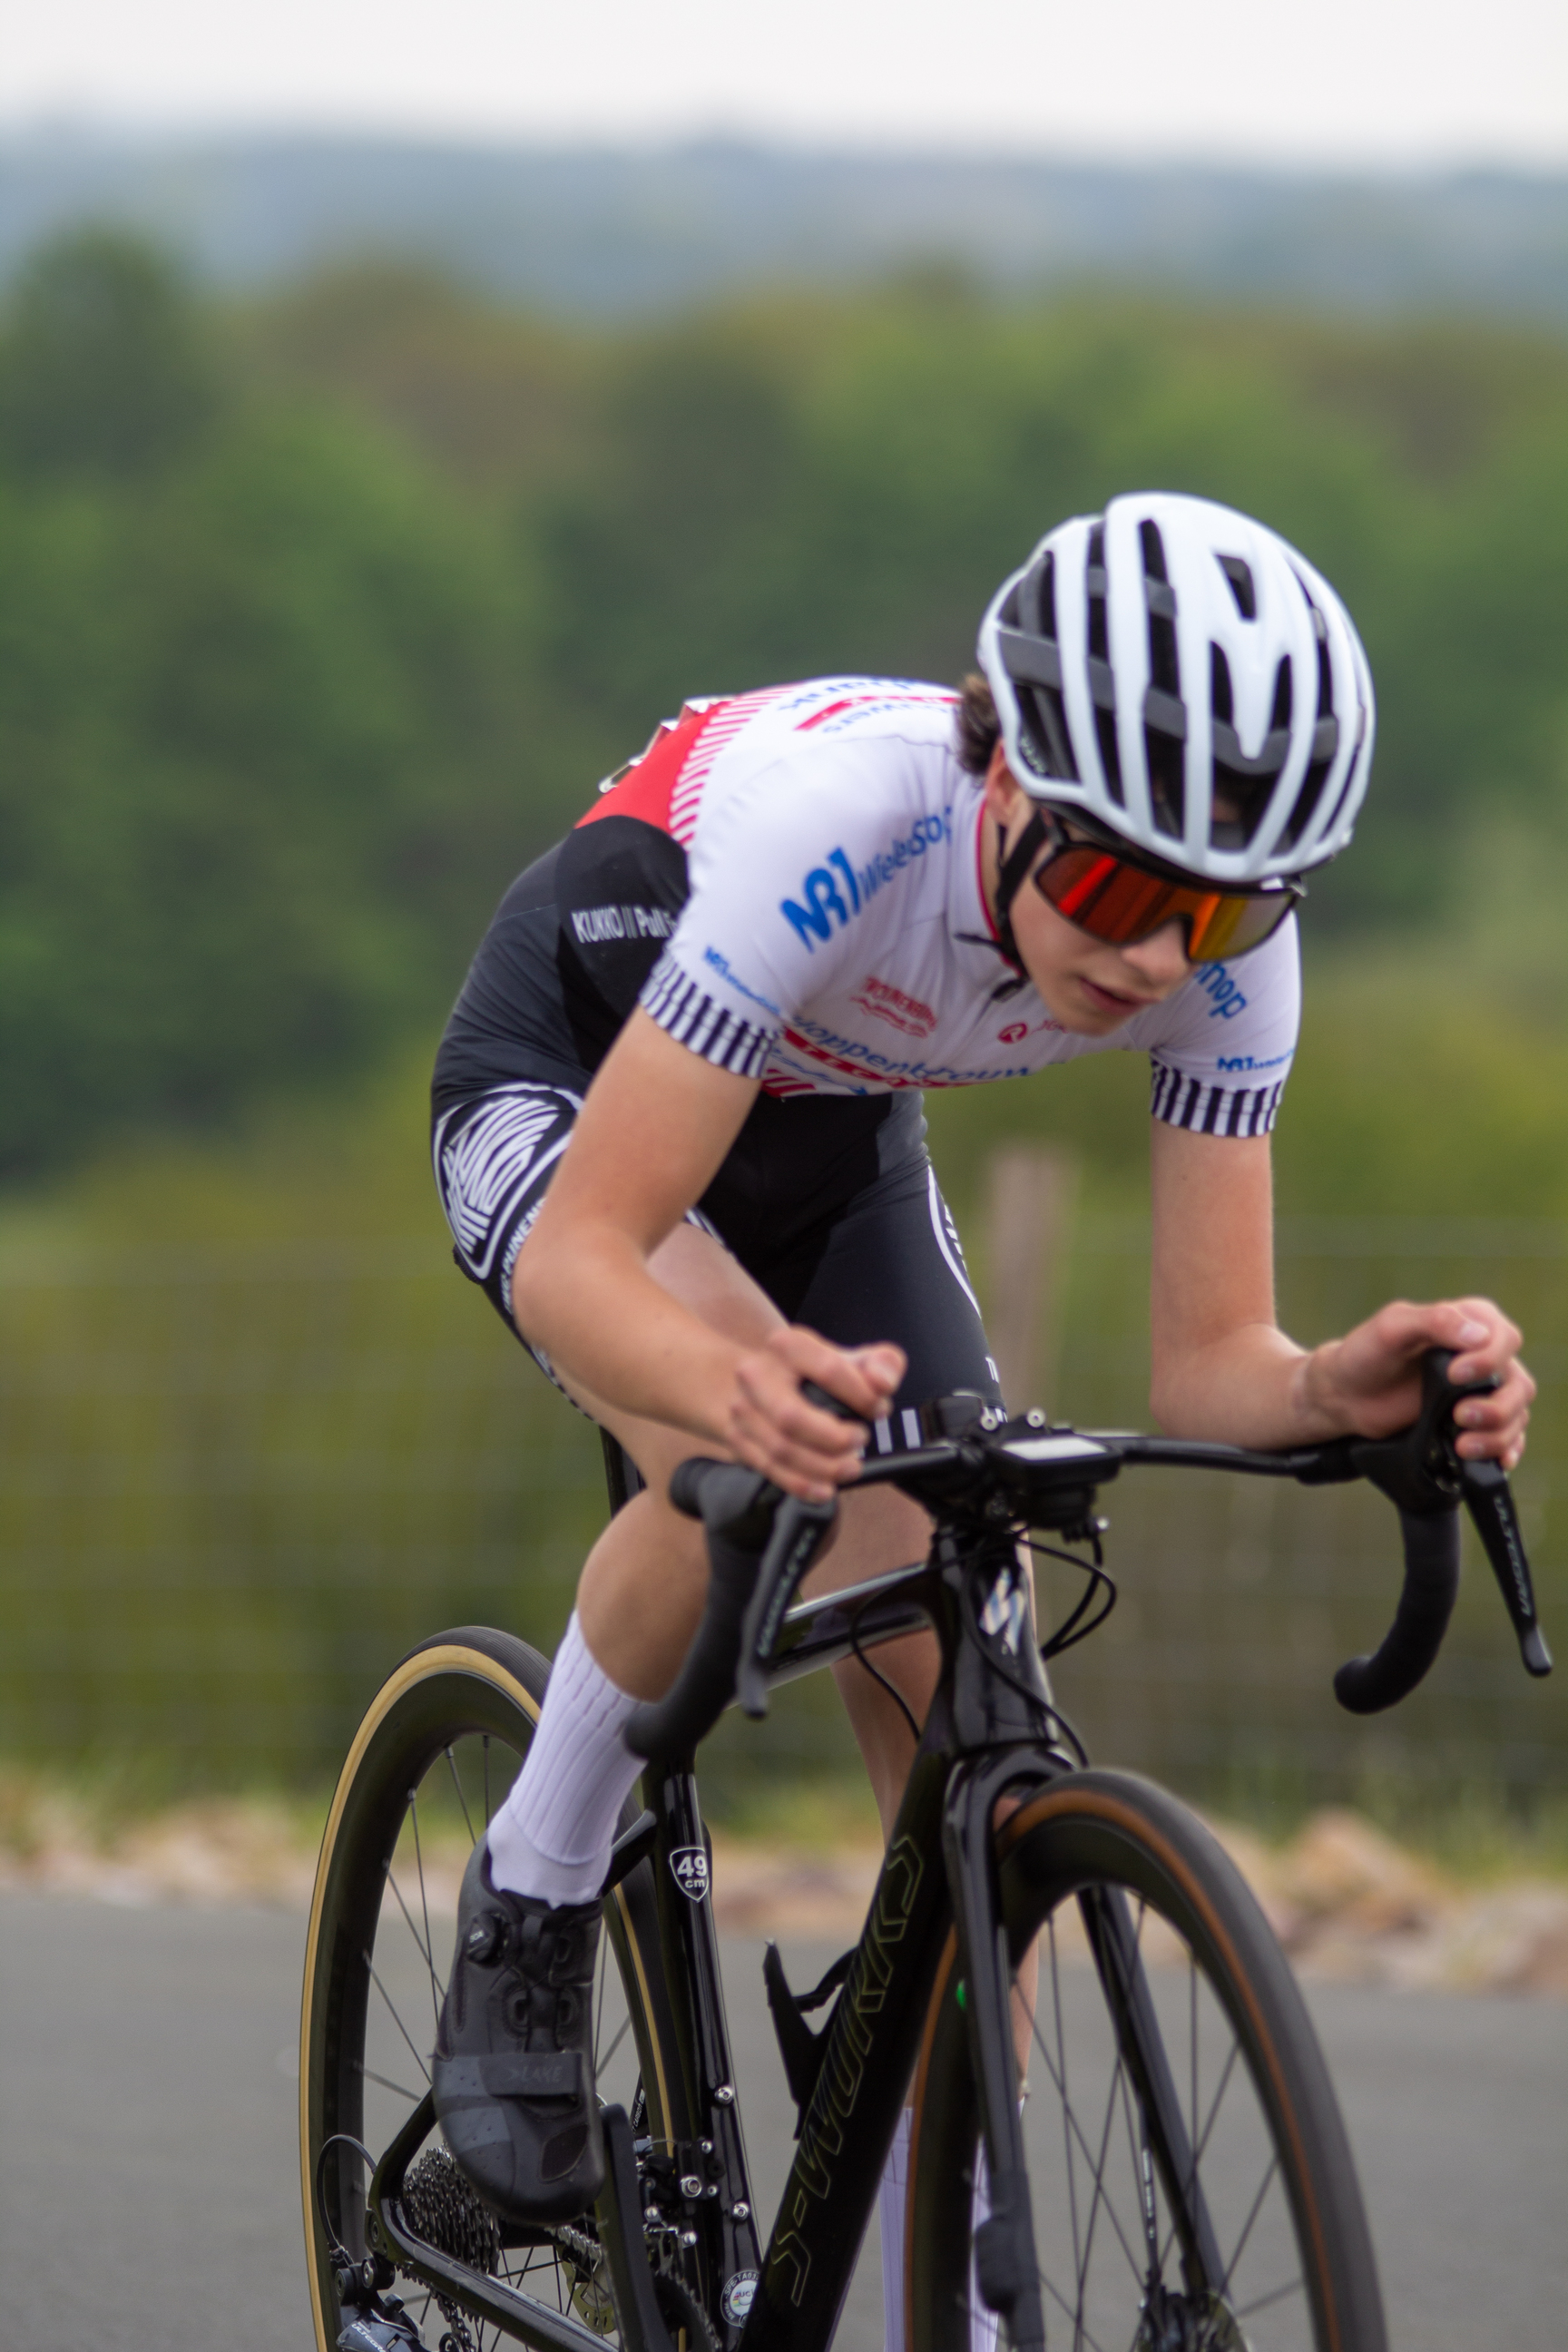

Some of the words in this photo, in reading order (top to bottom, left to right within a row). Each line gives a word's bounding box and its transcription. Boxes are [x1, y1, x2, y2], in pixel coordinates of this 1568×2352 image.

[572, 906, 625, 944] KUKKO
[677, 1856, 708, 1877] 49
[684, 1878, 705, 1888] cm
[523, 2065, 564, 2084] LAKE
